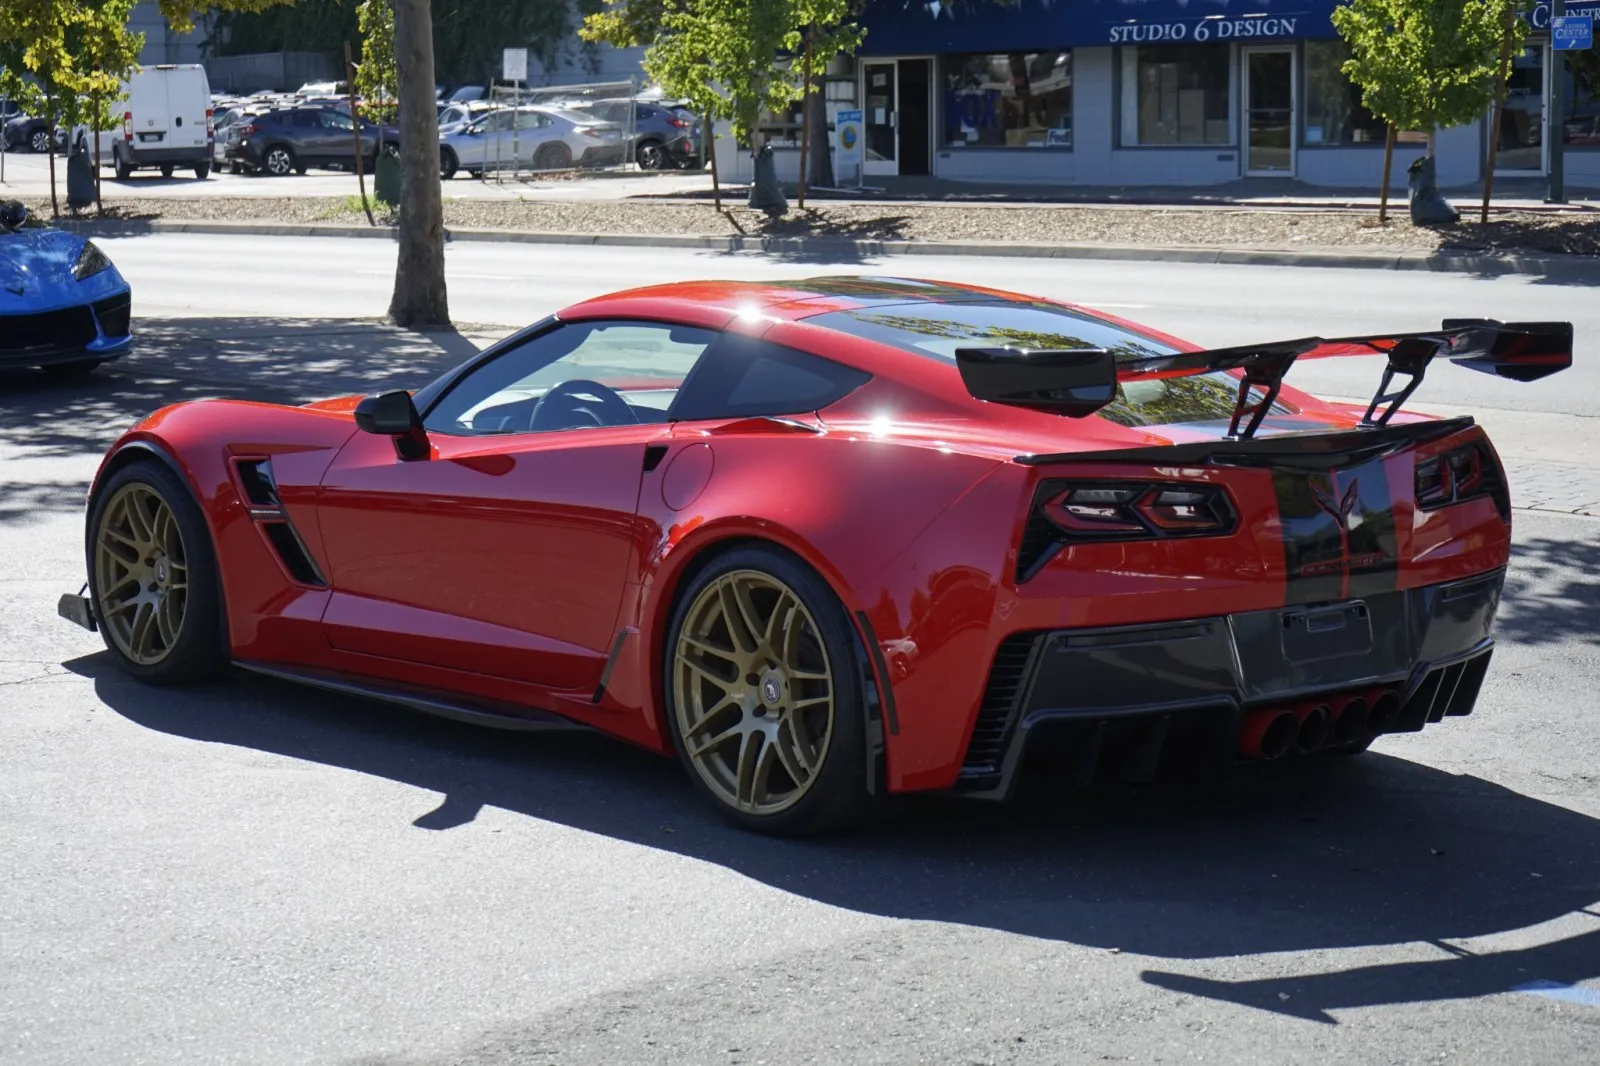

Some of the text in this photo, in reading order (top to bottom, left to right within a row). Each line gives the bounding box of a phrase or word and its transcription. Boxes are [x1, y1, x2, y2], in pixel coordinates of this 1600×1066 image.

[1109, 18, 1297, 42] STUDIO 6 DESIGN
[1555, 28, 1589, 39] CENTER
